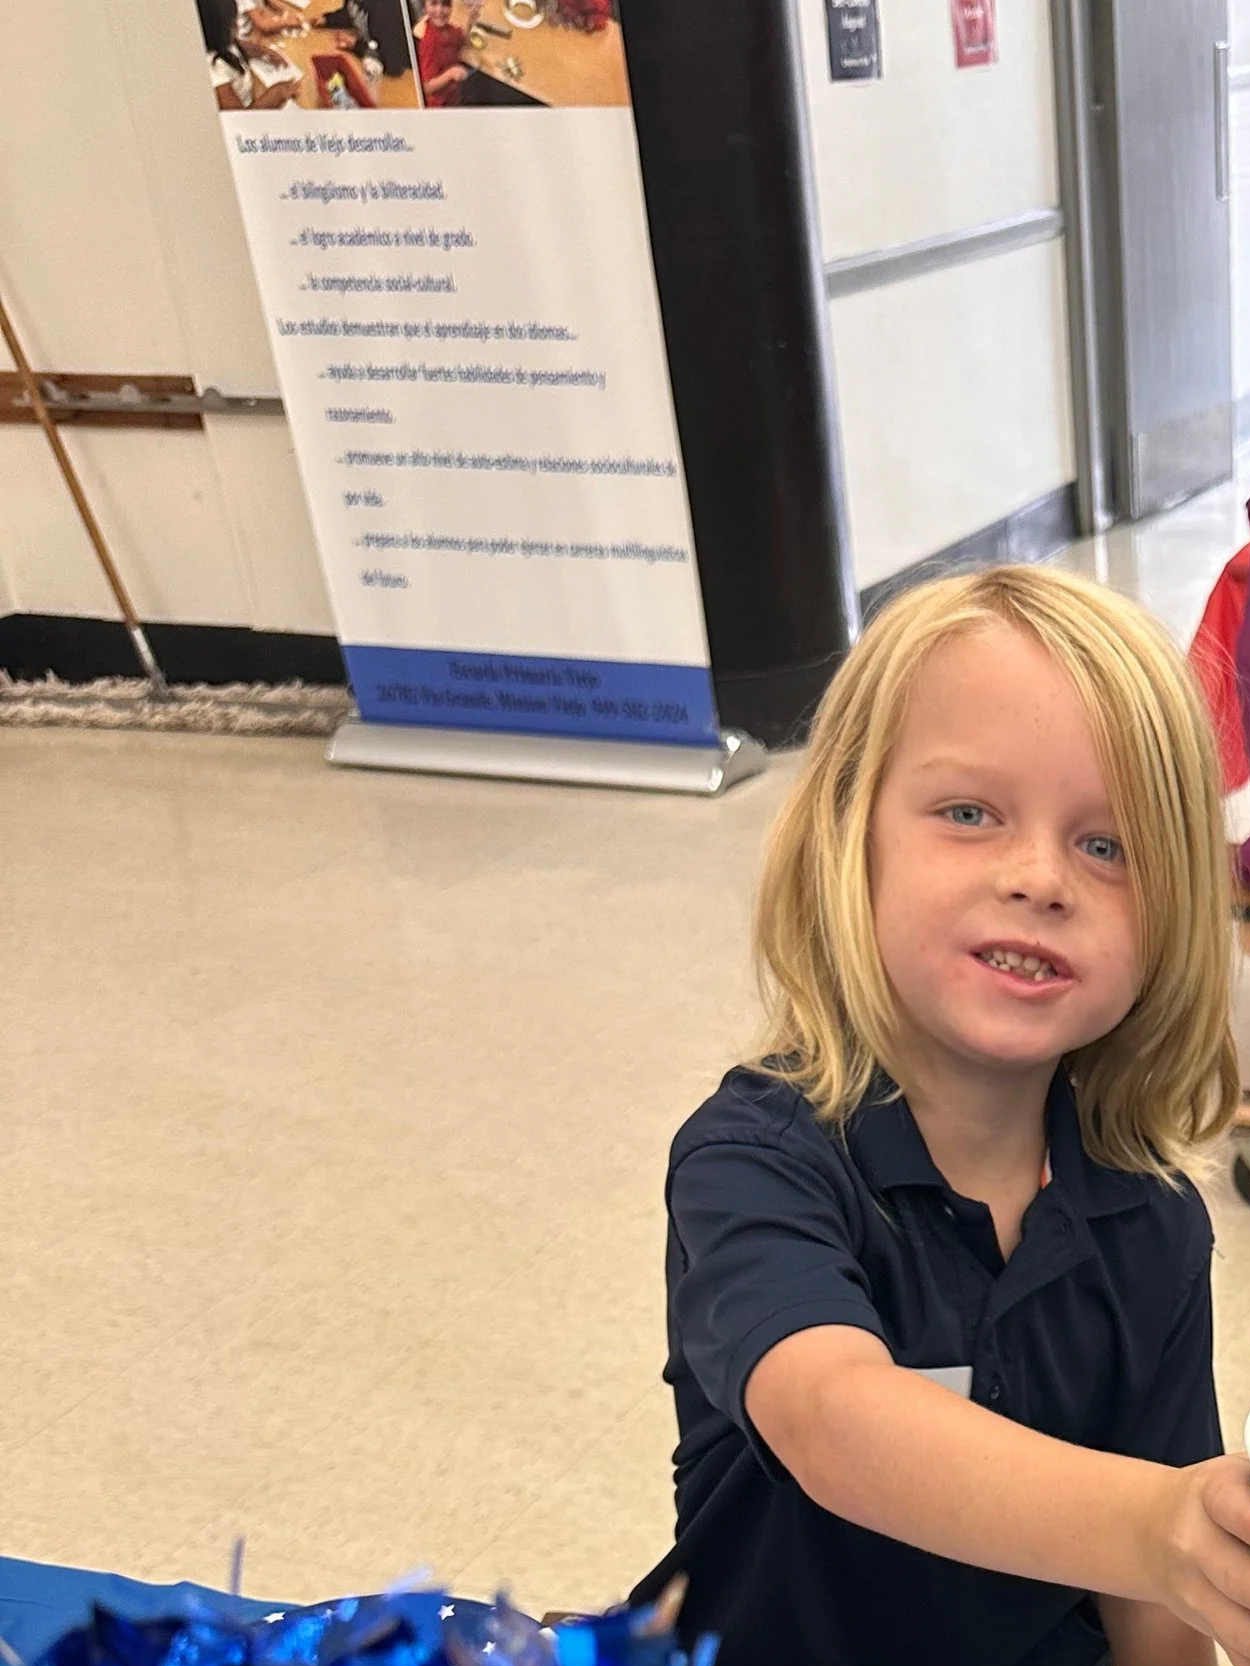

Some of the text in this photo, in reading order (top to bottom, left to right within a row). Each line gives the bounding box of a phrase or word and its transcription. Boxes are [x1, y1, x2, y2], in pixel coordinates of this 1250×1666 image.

[236, 134, 258, 152] Los
[259, 133, 302, 152] alumnos
[304, 132, 317, 152] de
[318, 132, 345, 156] Viejo
[428, 227, 439, 246] de
